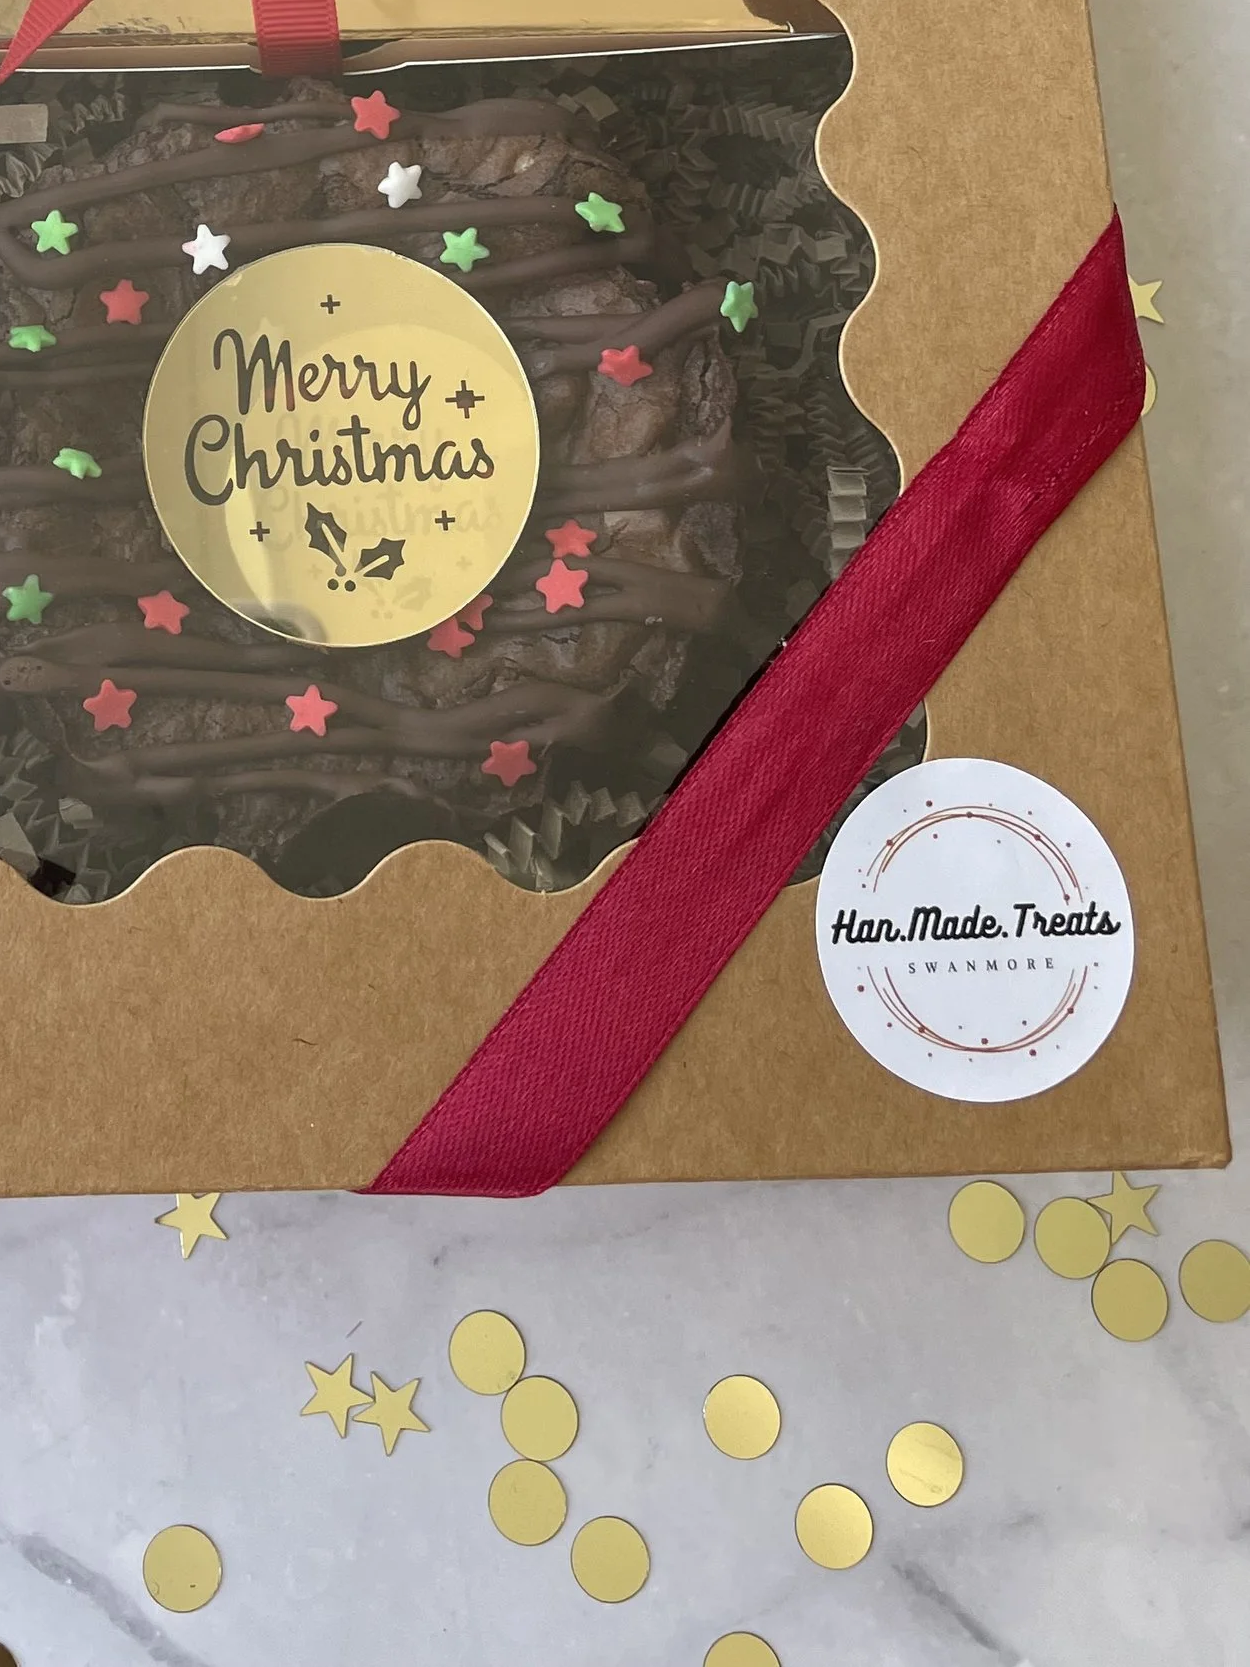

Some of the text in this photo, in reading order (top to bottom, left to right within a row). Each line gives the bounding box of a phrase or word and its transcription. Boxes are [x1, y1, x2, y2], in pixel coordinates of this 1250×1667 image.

[212, 328, 432, 431] Merry
[184, 414, 495, 506] Christmas
[831, 900, 1122, 945] Han.Made.Treats
[908, 956, 1055, 975] SWANMORE
